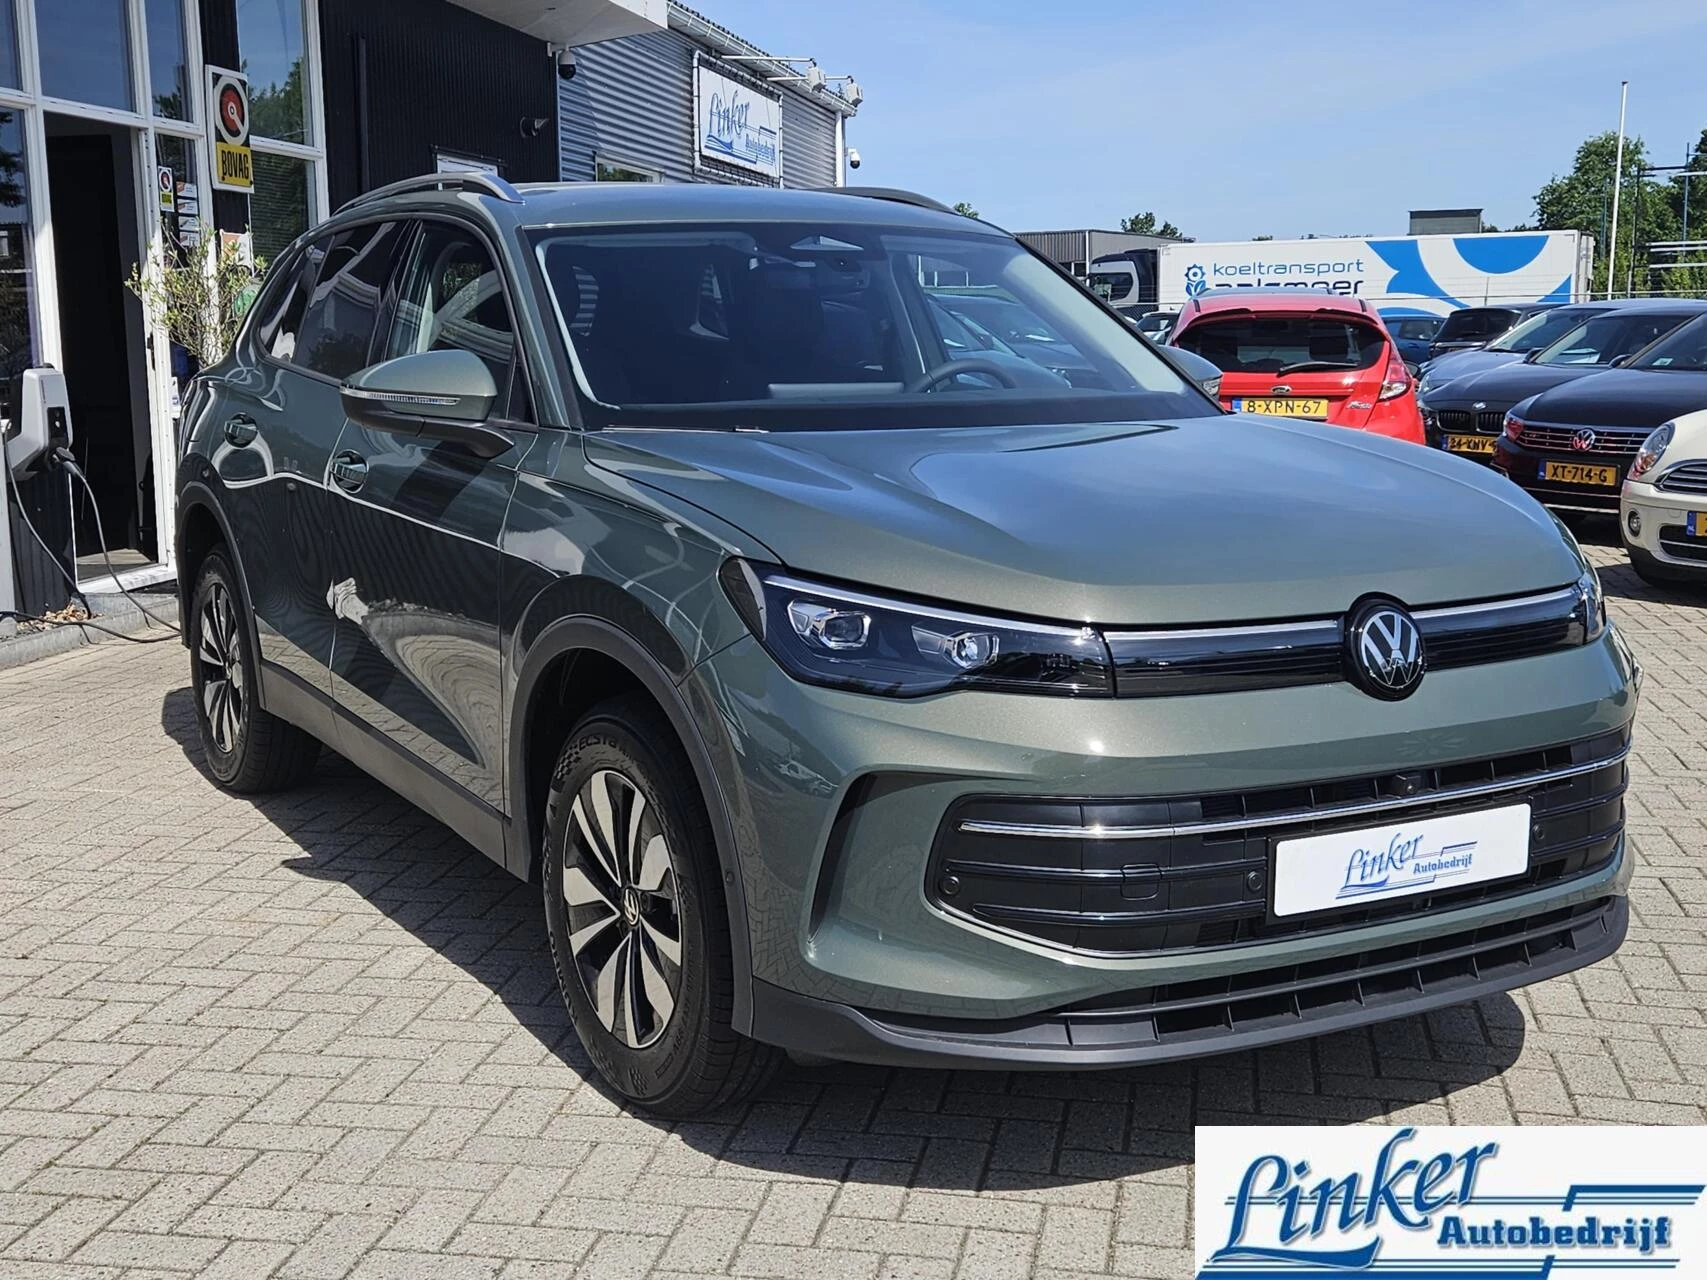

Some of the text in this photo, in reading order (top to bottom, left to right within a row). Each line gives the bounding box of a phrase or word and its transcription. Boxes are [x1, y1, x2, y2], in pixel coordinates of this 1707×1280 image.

[221, 150, 250, 180] BOVAG
[1213, 259, 1365, 276] koeltransport
[1247, 400, 1321, 414] 8-XPN-67
[1551, 464, 1608, 483] XT-714-G
[1340, 832, 1424, 889] Linker
[1413, 853, 1473, 875] Autobedrijf
